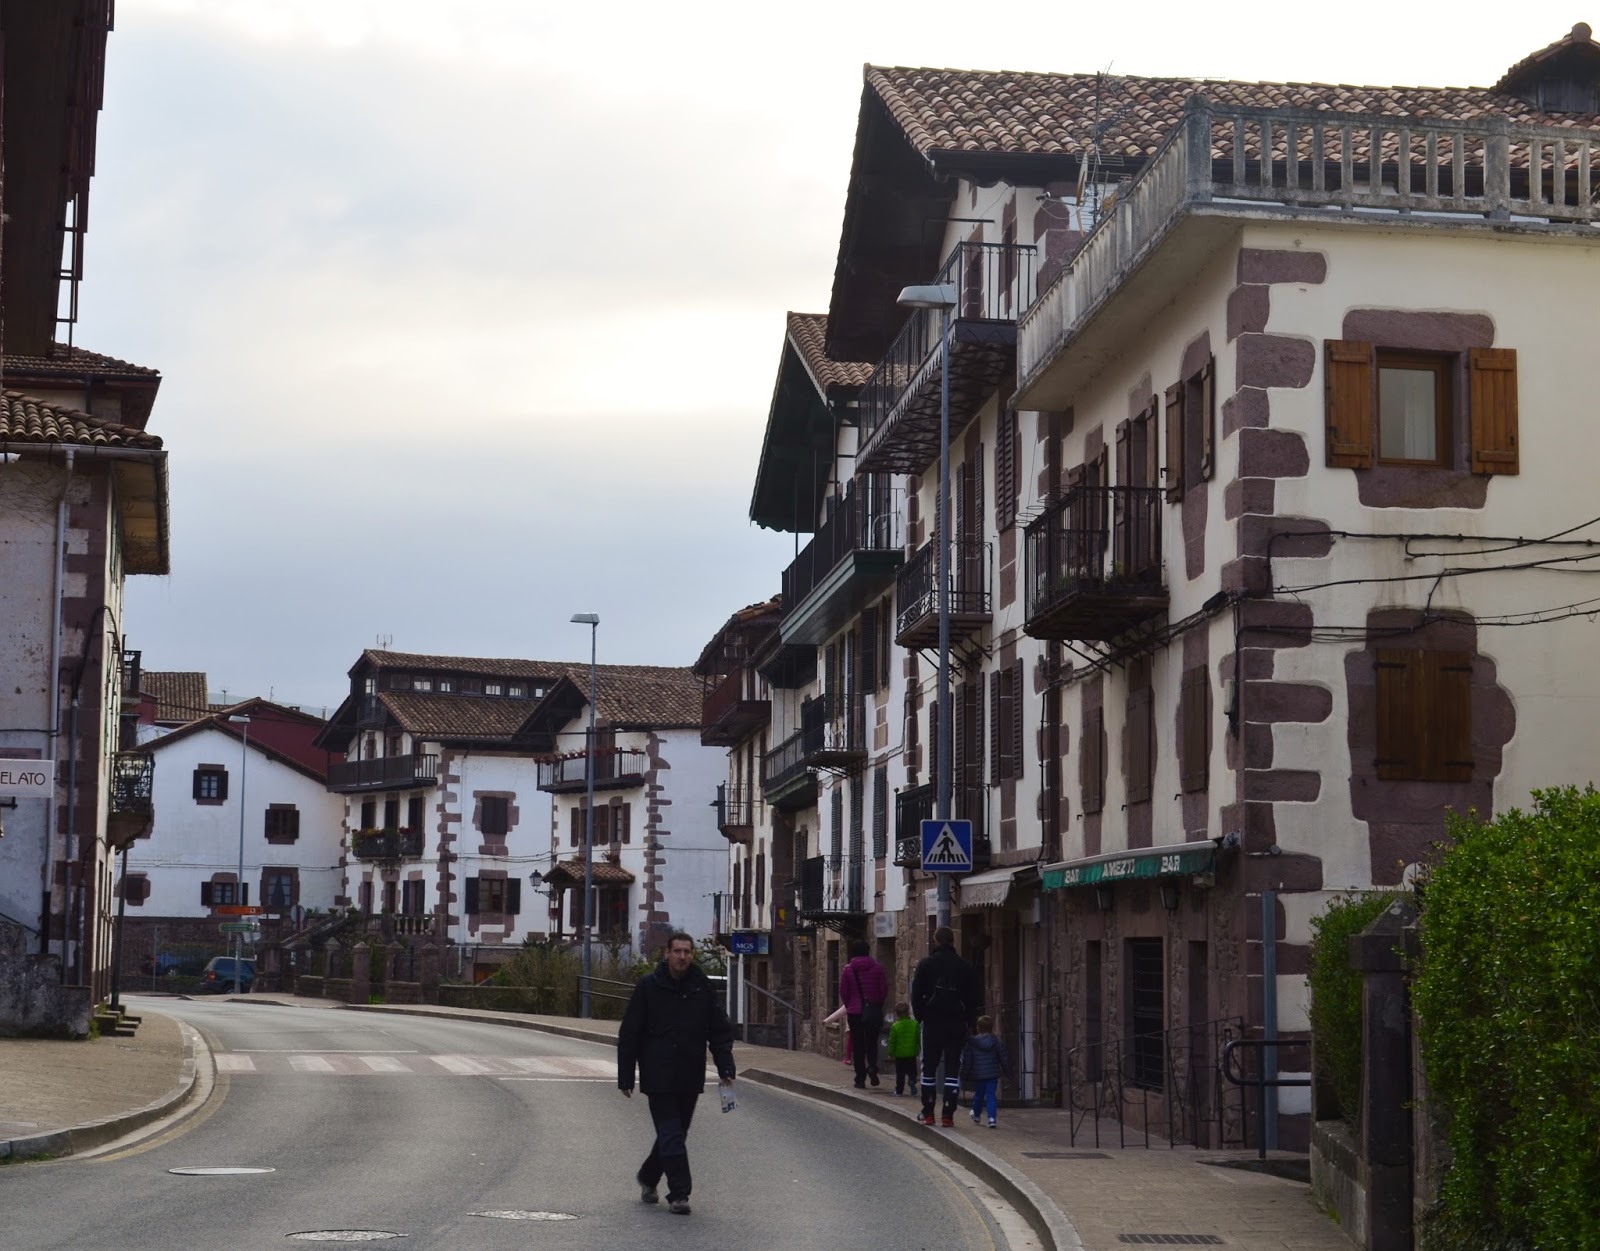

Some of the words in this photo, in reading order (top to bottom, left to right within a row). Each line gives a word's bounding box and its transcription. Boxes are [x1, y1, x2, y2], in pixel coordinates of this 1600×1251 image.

[0, 771, 46, 786] ELATO
[1160, 854, 1181, 873] BAR
[736, 942, 754, 950] MGS
